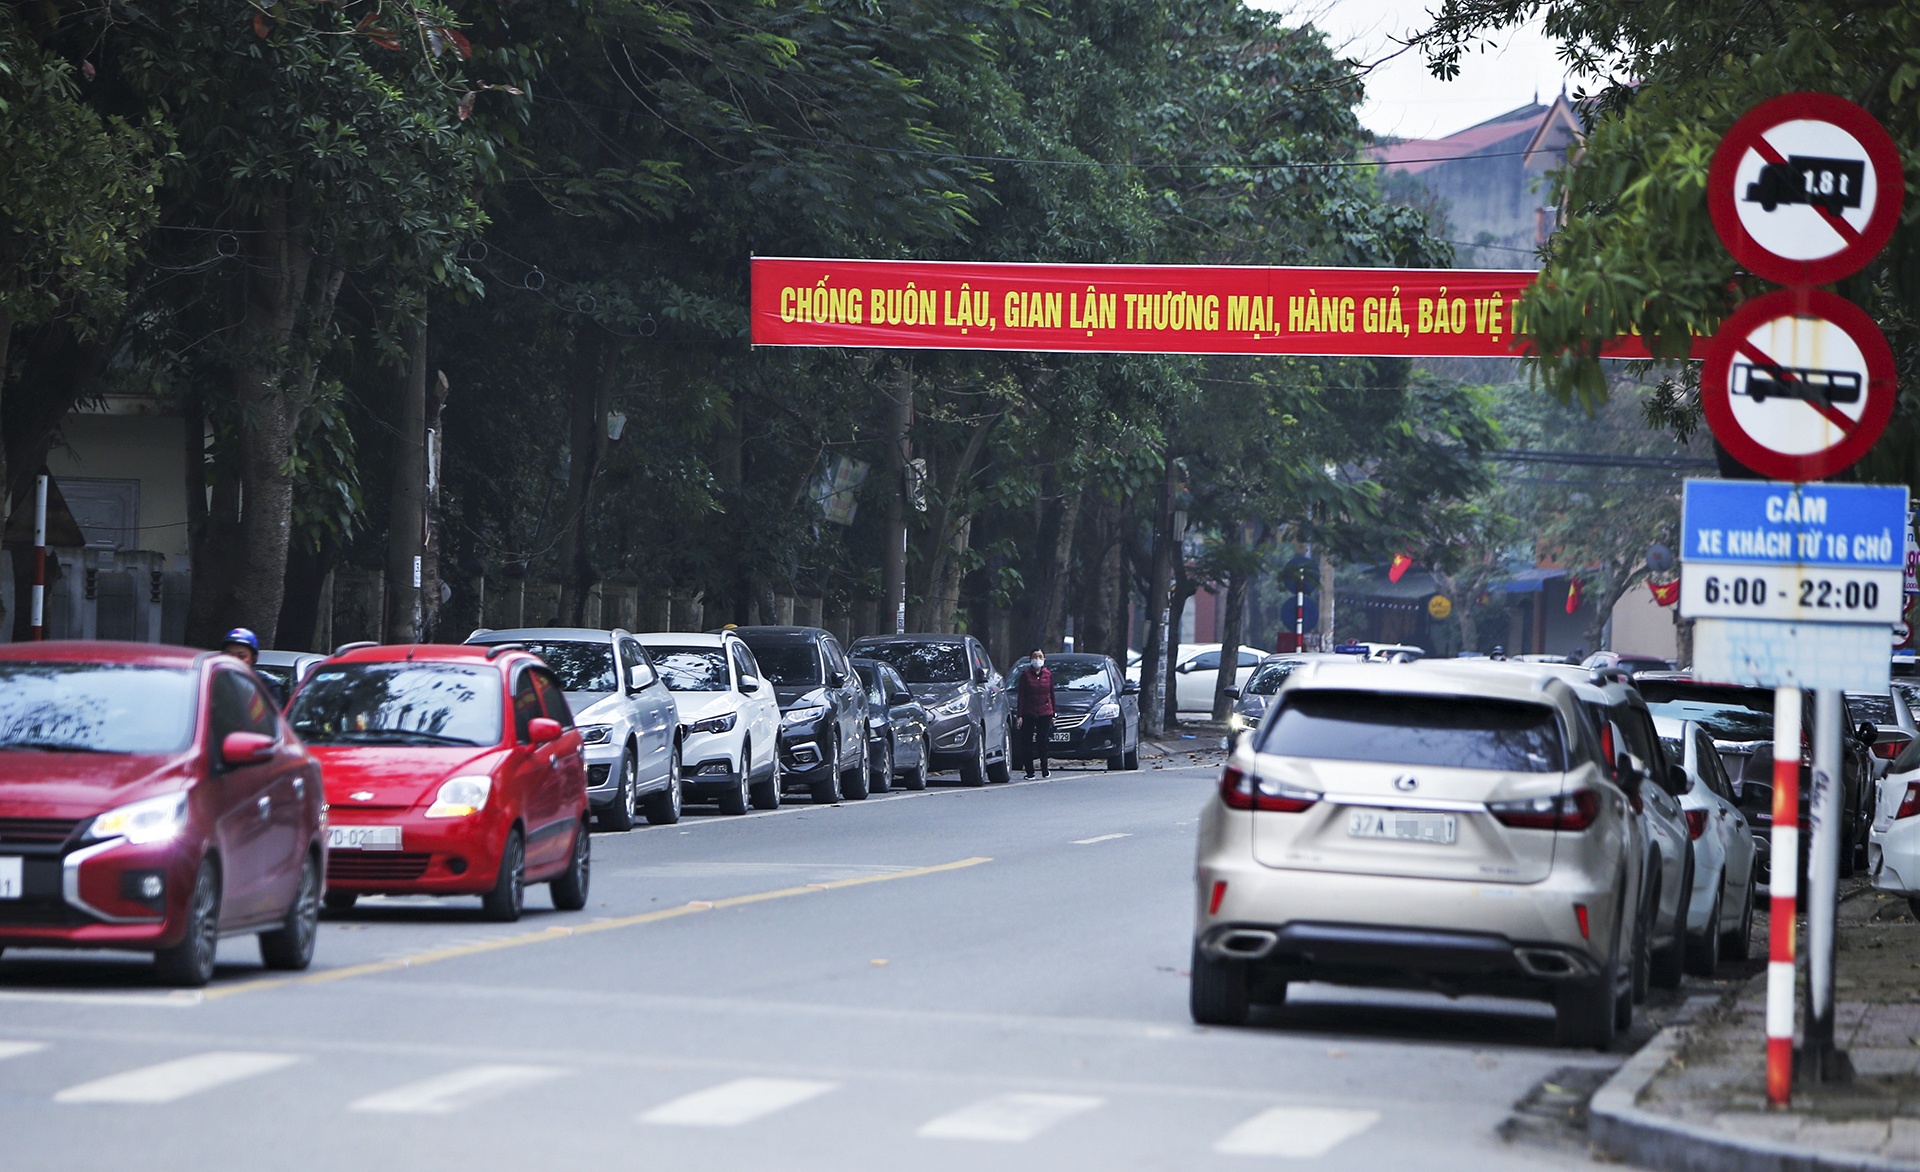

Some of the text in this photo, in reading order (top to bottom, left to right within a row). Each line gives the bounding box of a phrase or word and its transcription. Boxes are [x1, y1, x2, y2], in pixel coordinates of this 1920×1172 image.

[780, 275, 863, 324] CHỐNG
[870, 281, 937, 325] BUÔN
[944, 283, 996, 335] LẬU,
[1004, 291, 1062, 328] GIAN
[1070, 285, 1117, 337] LẬN
[1124, 291, 1219, 331] THƯƠNG
[1227, 295, 1280, 340] MẠI,
[1289, 288, 1355, 333] HÀNG
[1363, 285, 1410, 338] GIẢ,
[1418, 286, 1467, 334] BẢO
[1474, 290, 1503, 342] VỆ
[1766, 489, 1827, 524] CẤM
[1698, 526, 1892, 562] XE KHÁCH TỪ 16 CHỖ
[1705, 576, 1767, 606] 6:00
[1798, 579, 1879, 610] 22:00
